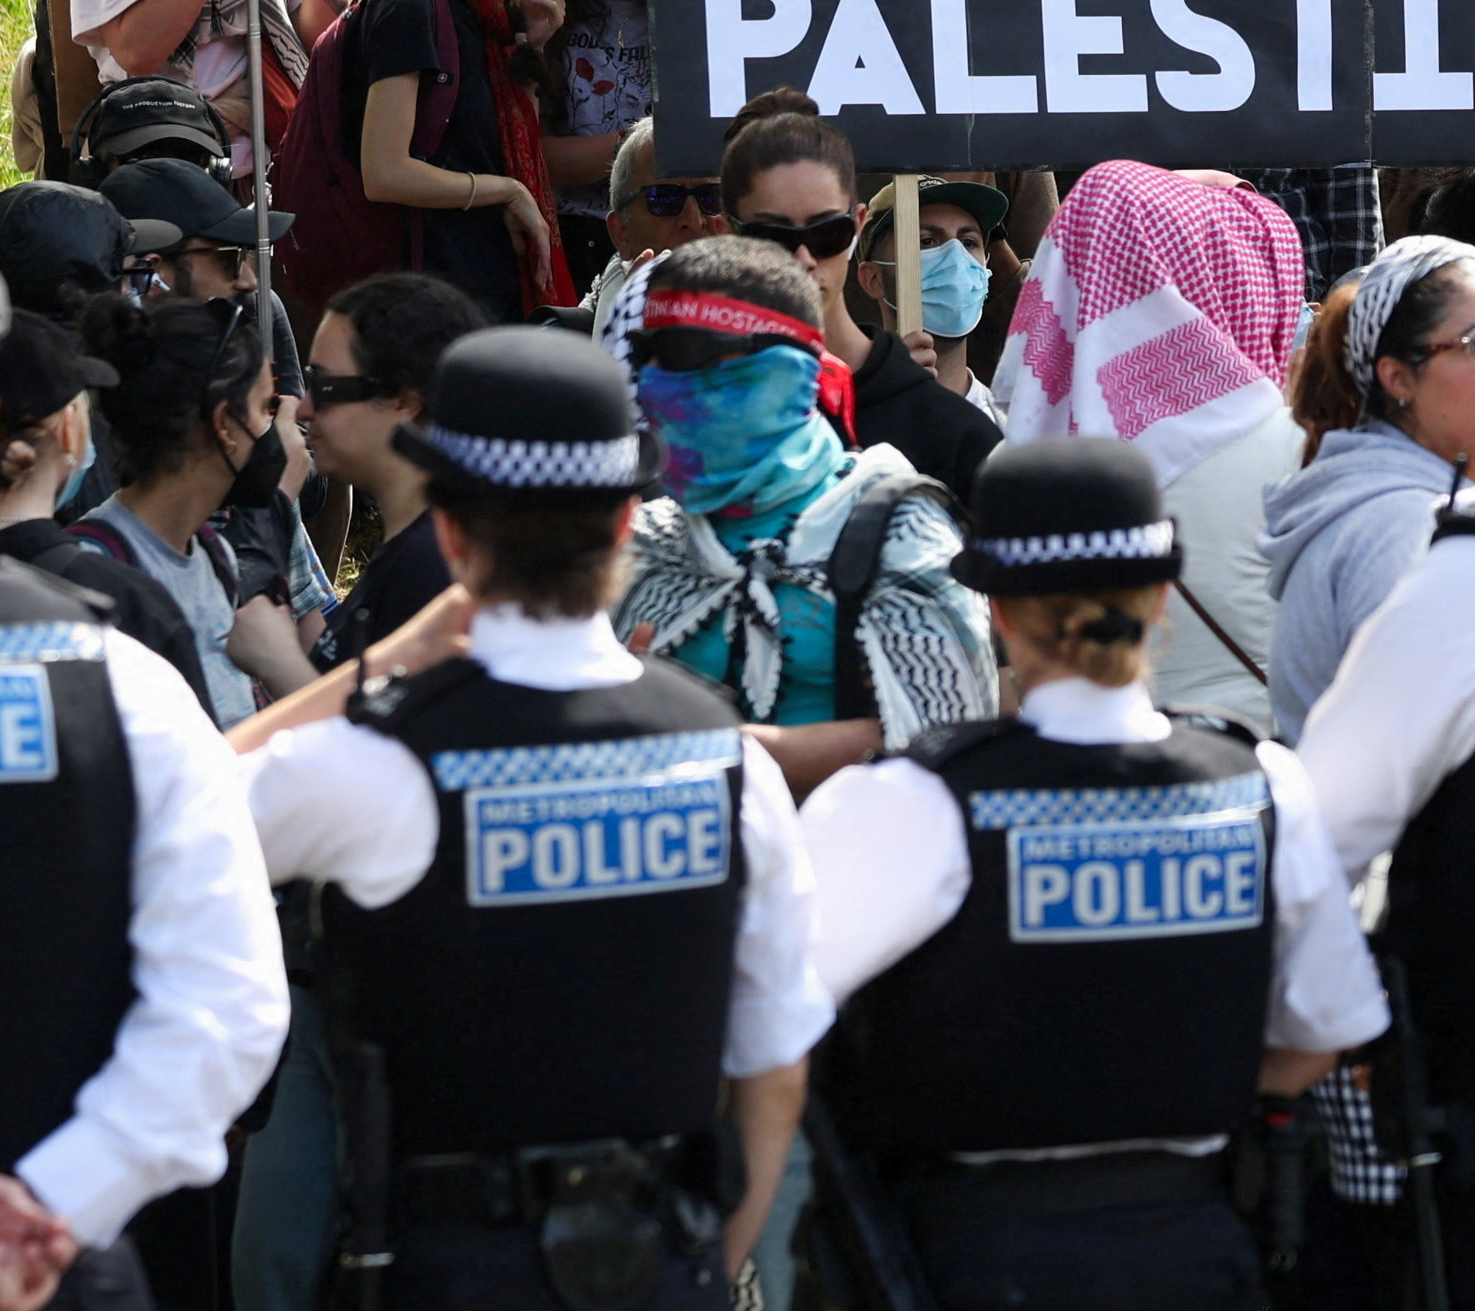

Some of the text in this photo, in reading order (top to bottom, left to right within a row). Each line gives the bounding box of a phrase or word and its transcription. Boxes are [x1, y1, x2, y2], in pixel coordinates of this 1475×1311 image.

[482, 783, 717, 824] METROPOLITAN
[482, 808, 720, 894] POLICE
[1024, 826, 1254, 861] METROPOLITAN
[1024, 851, 1256, 927] POLICE
